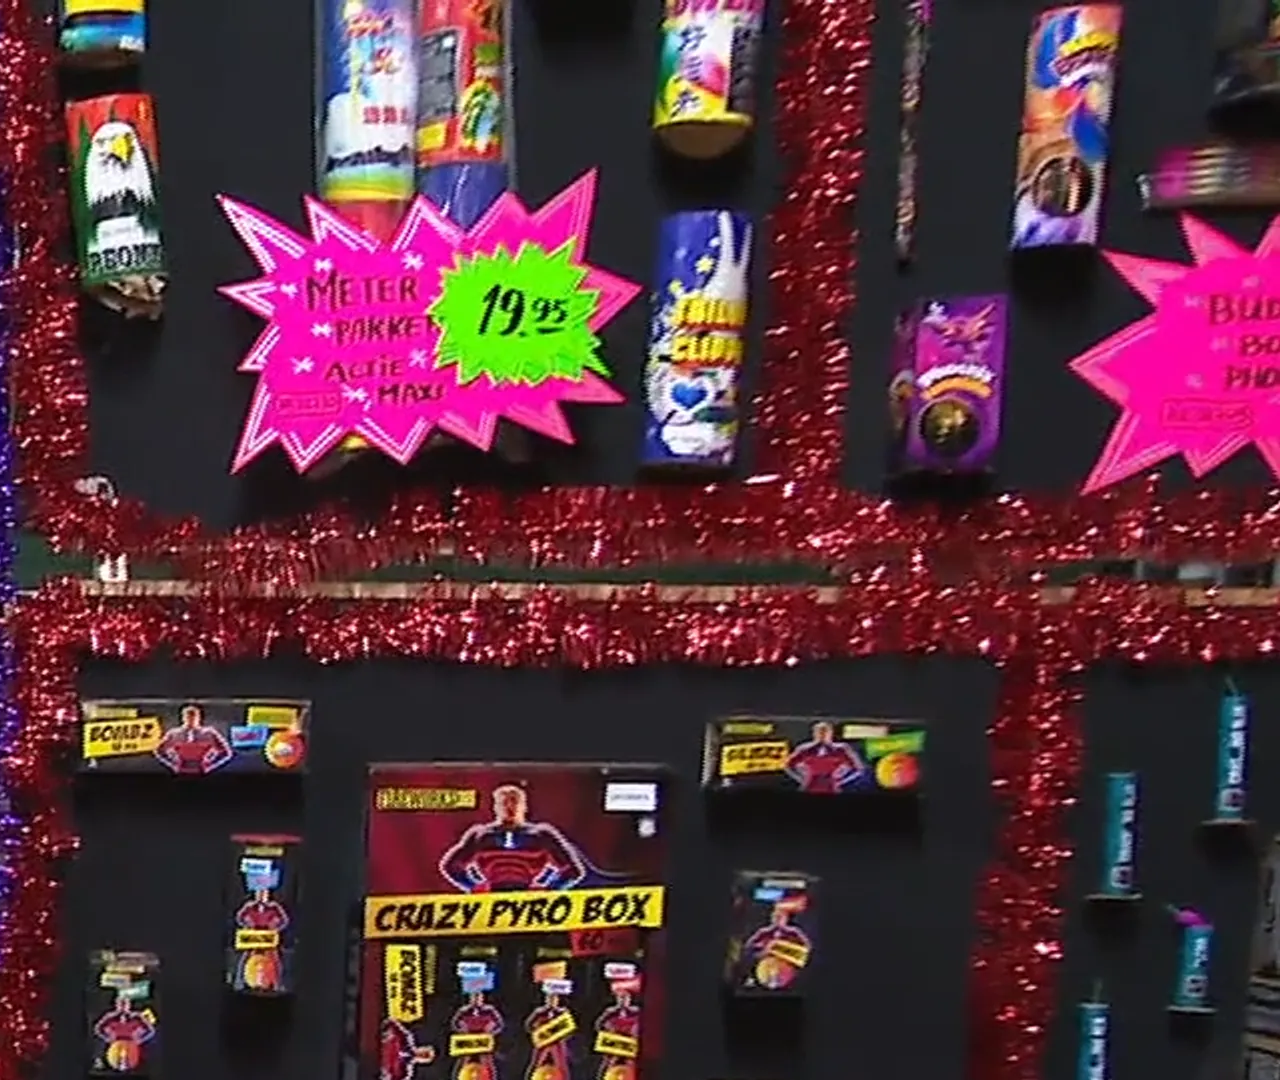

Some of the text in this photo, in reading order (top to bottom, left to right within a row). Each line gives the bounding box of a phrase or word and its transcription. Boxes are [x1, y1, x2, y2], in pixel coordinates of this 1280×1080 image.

[306, 273, 419, 312] METER
[374, 892, 652, 932] CRAZY PYRO BOX
